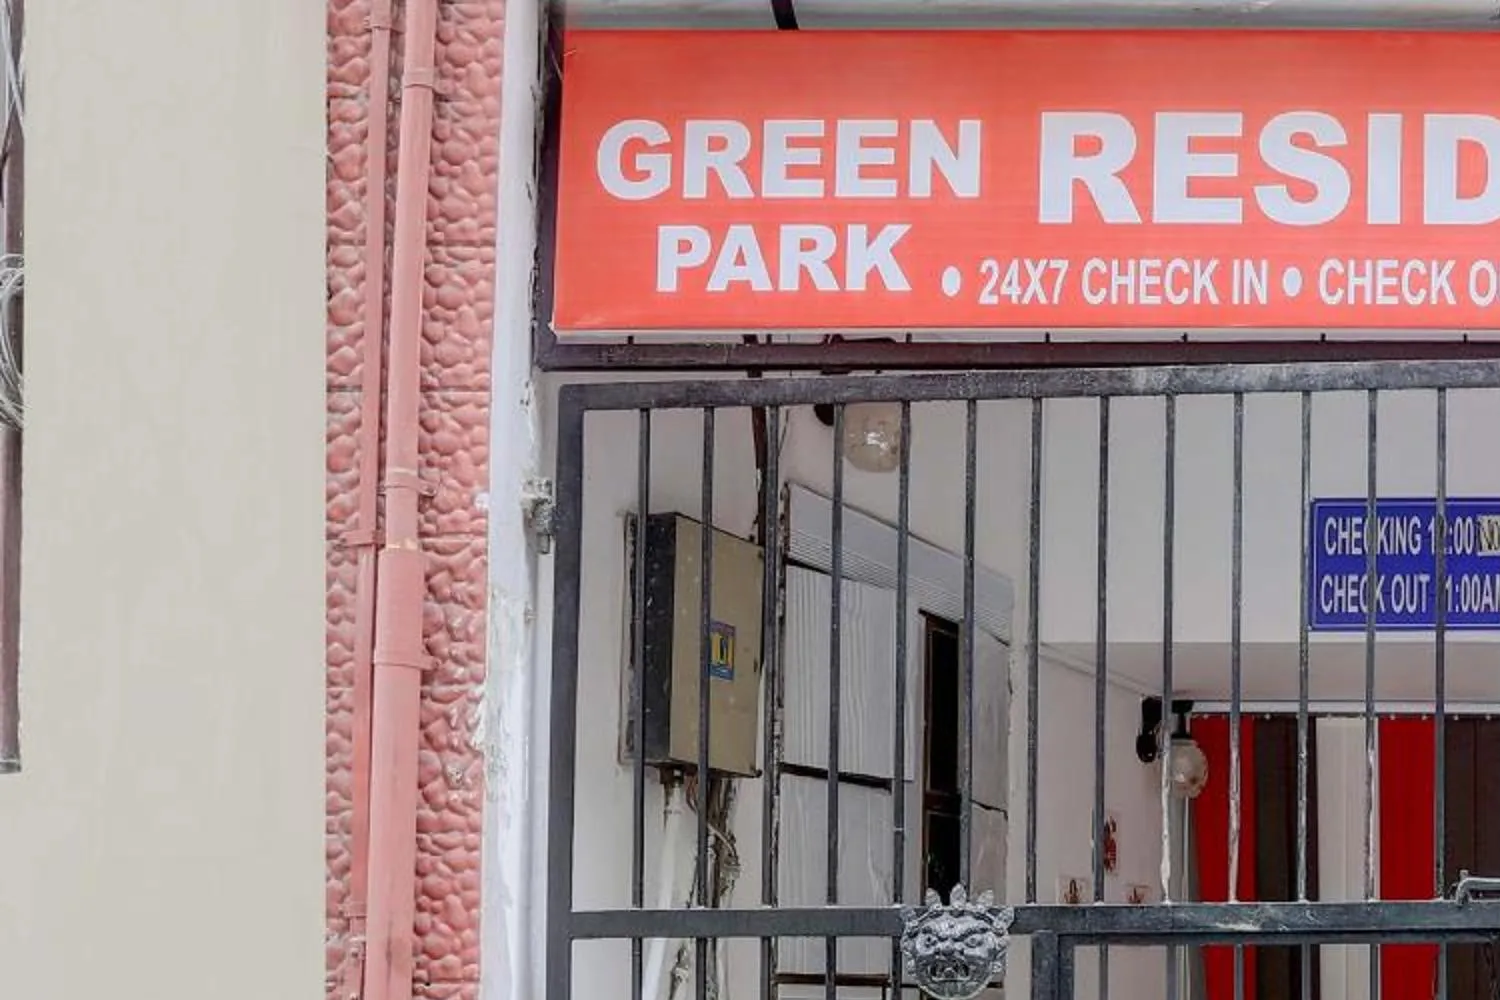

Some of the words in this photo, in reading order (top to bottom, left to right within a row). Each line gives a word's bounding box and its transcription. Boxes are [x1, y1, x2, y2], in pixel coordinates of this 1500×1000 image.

[597, 119, 981, 201] GREEN
[657, 223, 913, 293] PARK
[979, 258, 1069, 305] 24X7
[1081, 257, 1220, 305] CHECK
[1231, 258, 1269, 305] IN
[1318, 258, 1457, 306] CHECK
[1391, 573, 1431, 614] OUT
